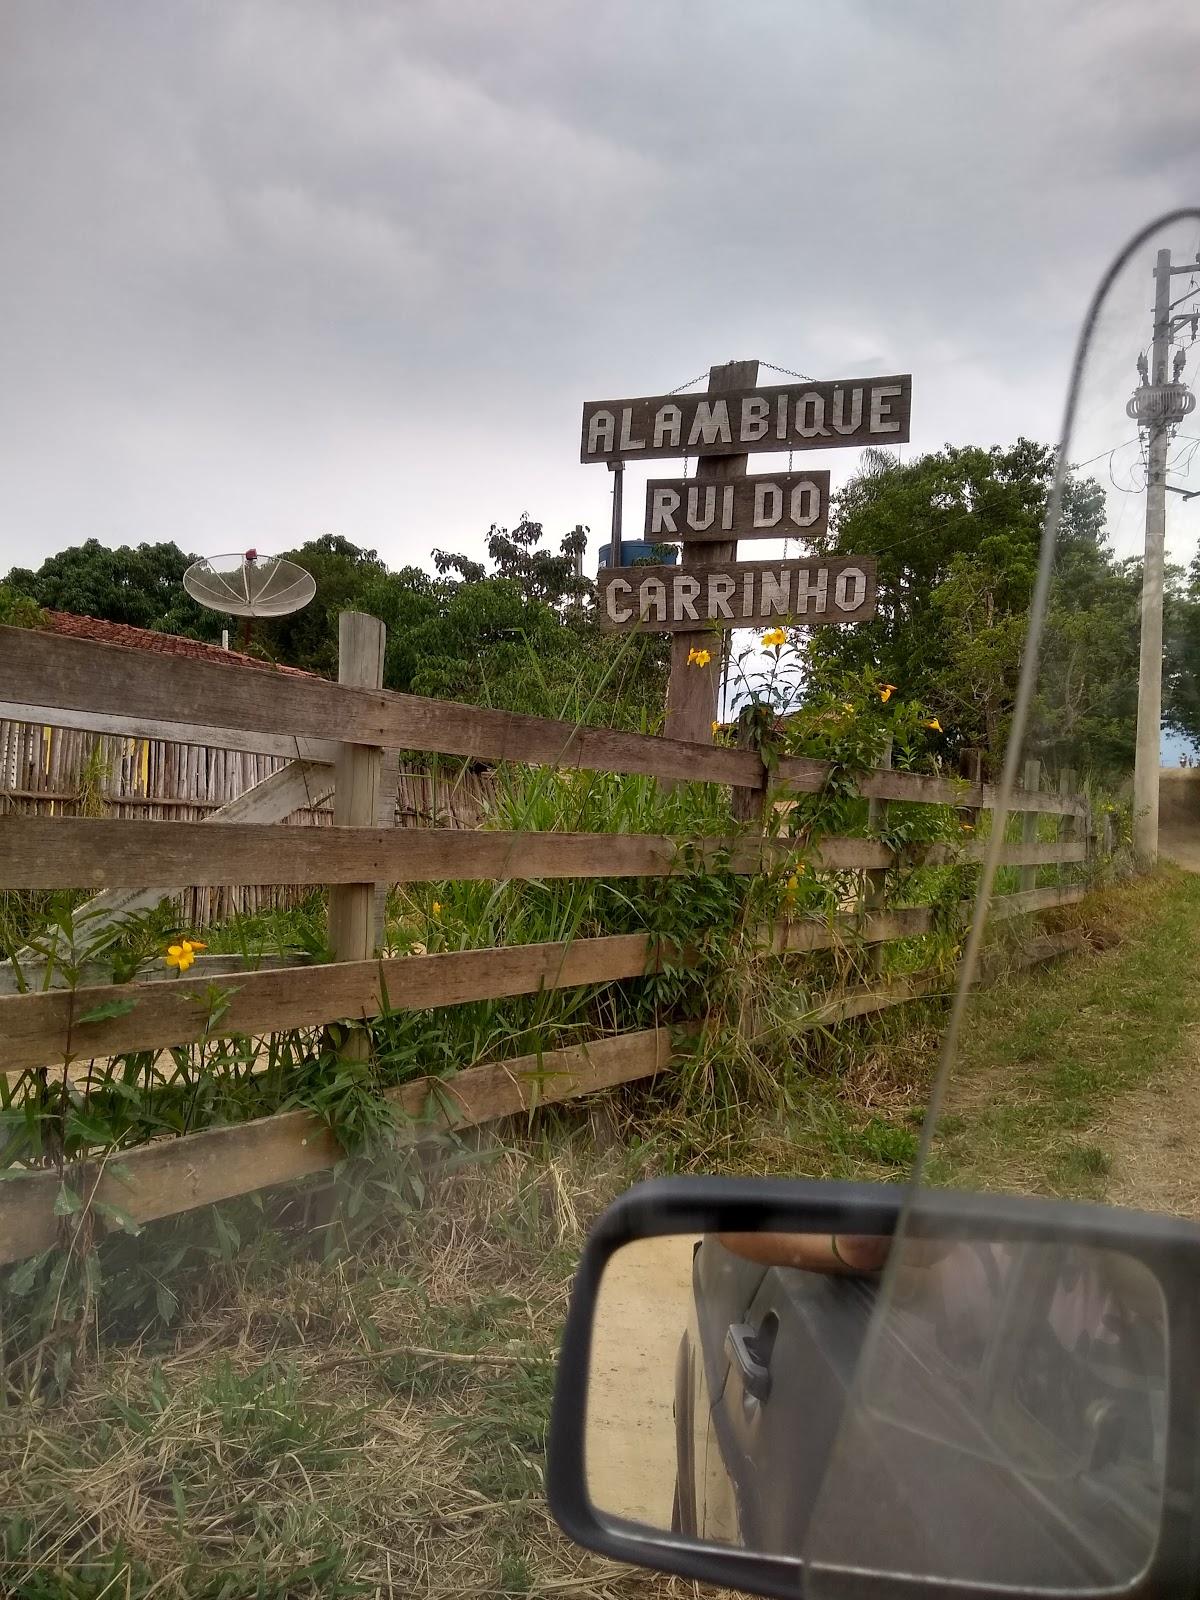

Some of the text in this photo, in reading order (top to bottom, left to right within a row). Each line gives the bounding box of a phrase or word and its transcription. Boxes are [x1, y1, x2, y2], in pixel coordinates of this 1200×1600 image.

[587, 385, 902, 454] ALAMBIQUE
[651, 480, 821, 533] RUI DO
[605, 567, 867, 624] CARRINHO
